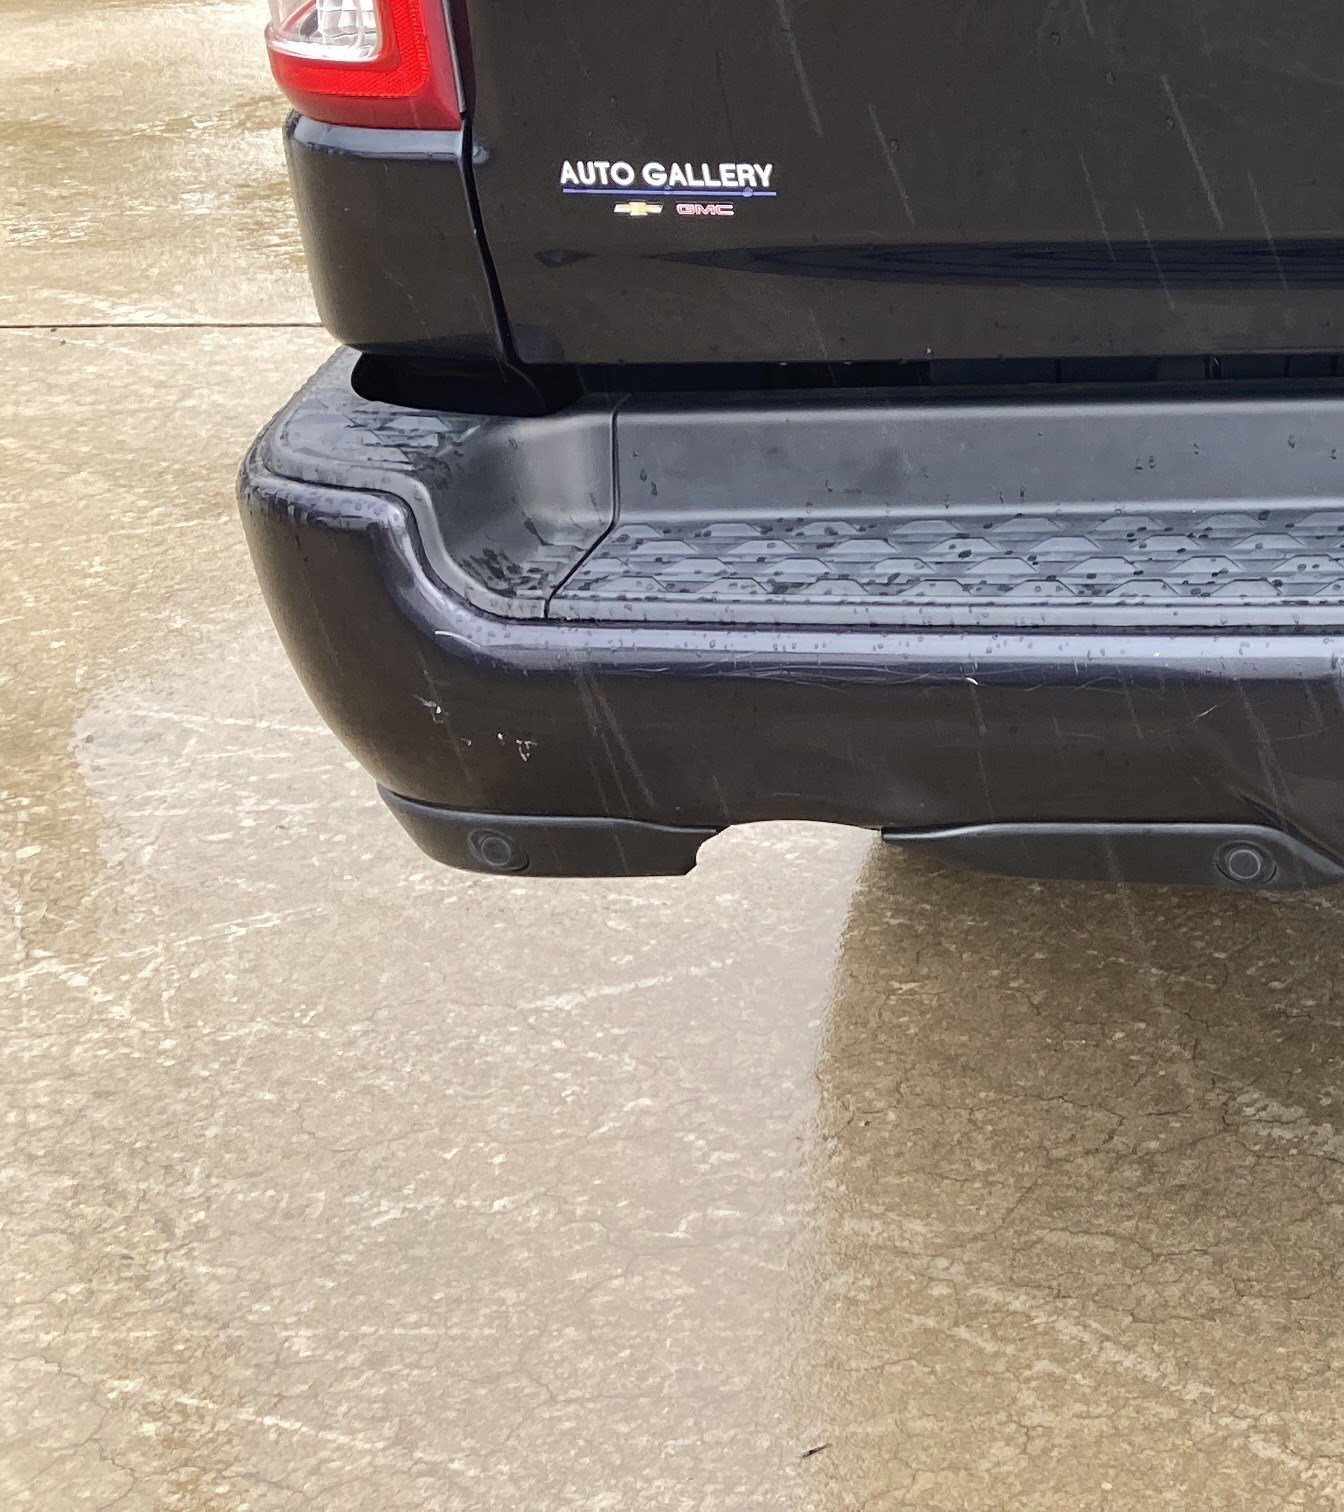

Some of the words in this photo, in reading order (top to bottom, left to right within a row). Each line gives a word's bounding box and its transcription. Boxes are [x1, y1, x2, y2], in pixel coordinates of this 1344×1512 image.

[560, 160, 635, 187] AUTO
[642, 162, 773, 188] GALLERY
[675, 202, 735, 216] GMC
